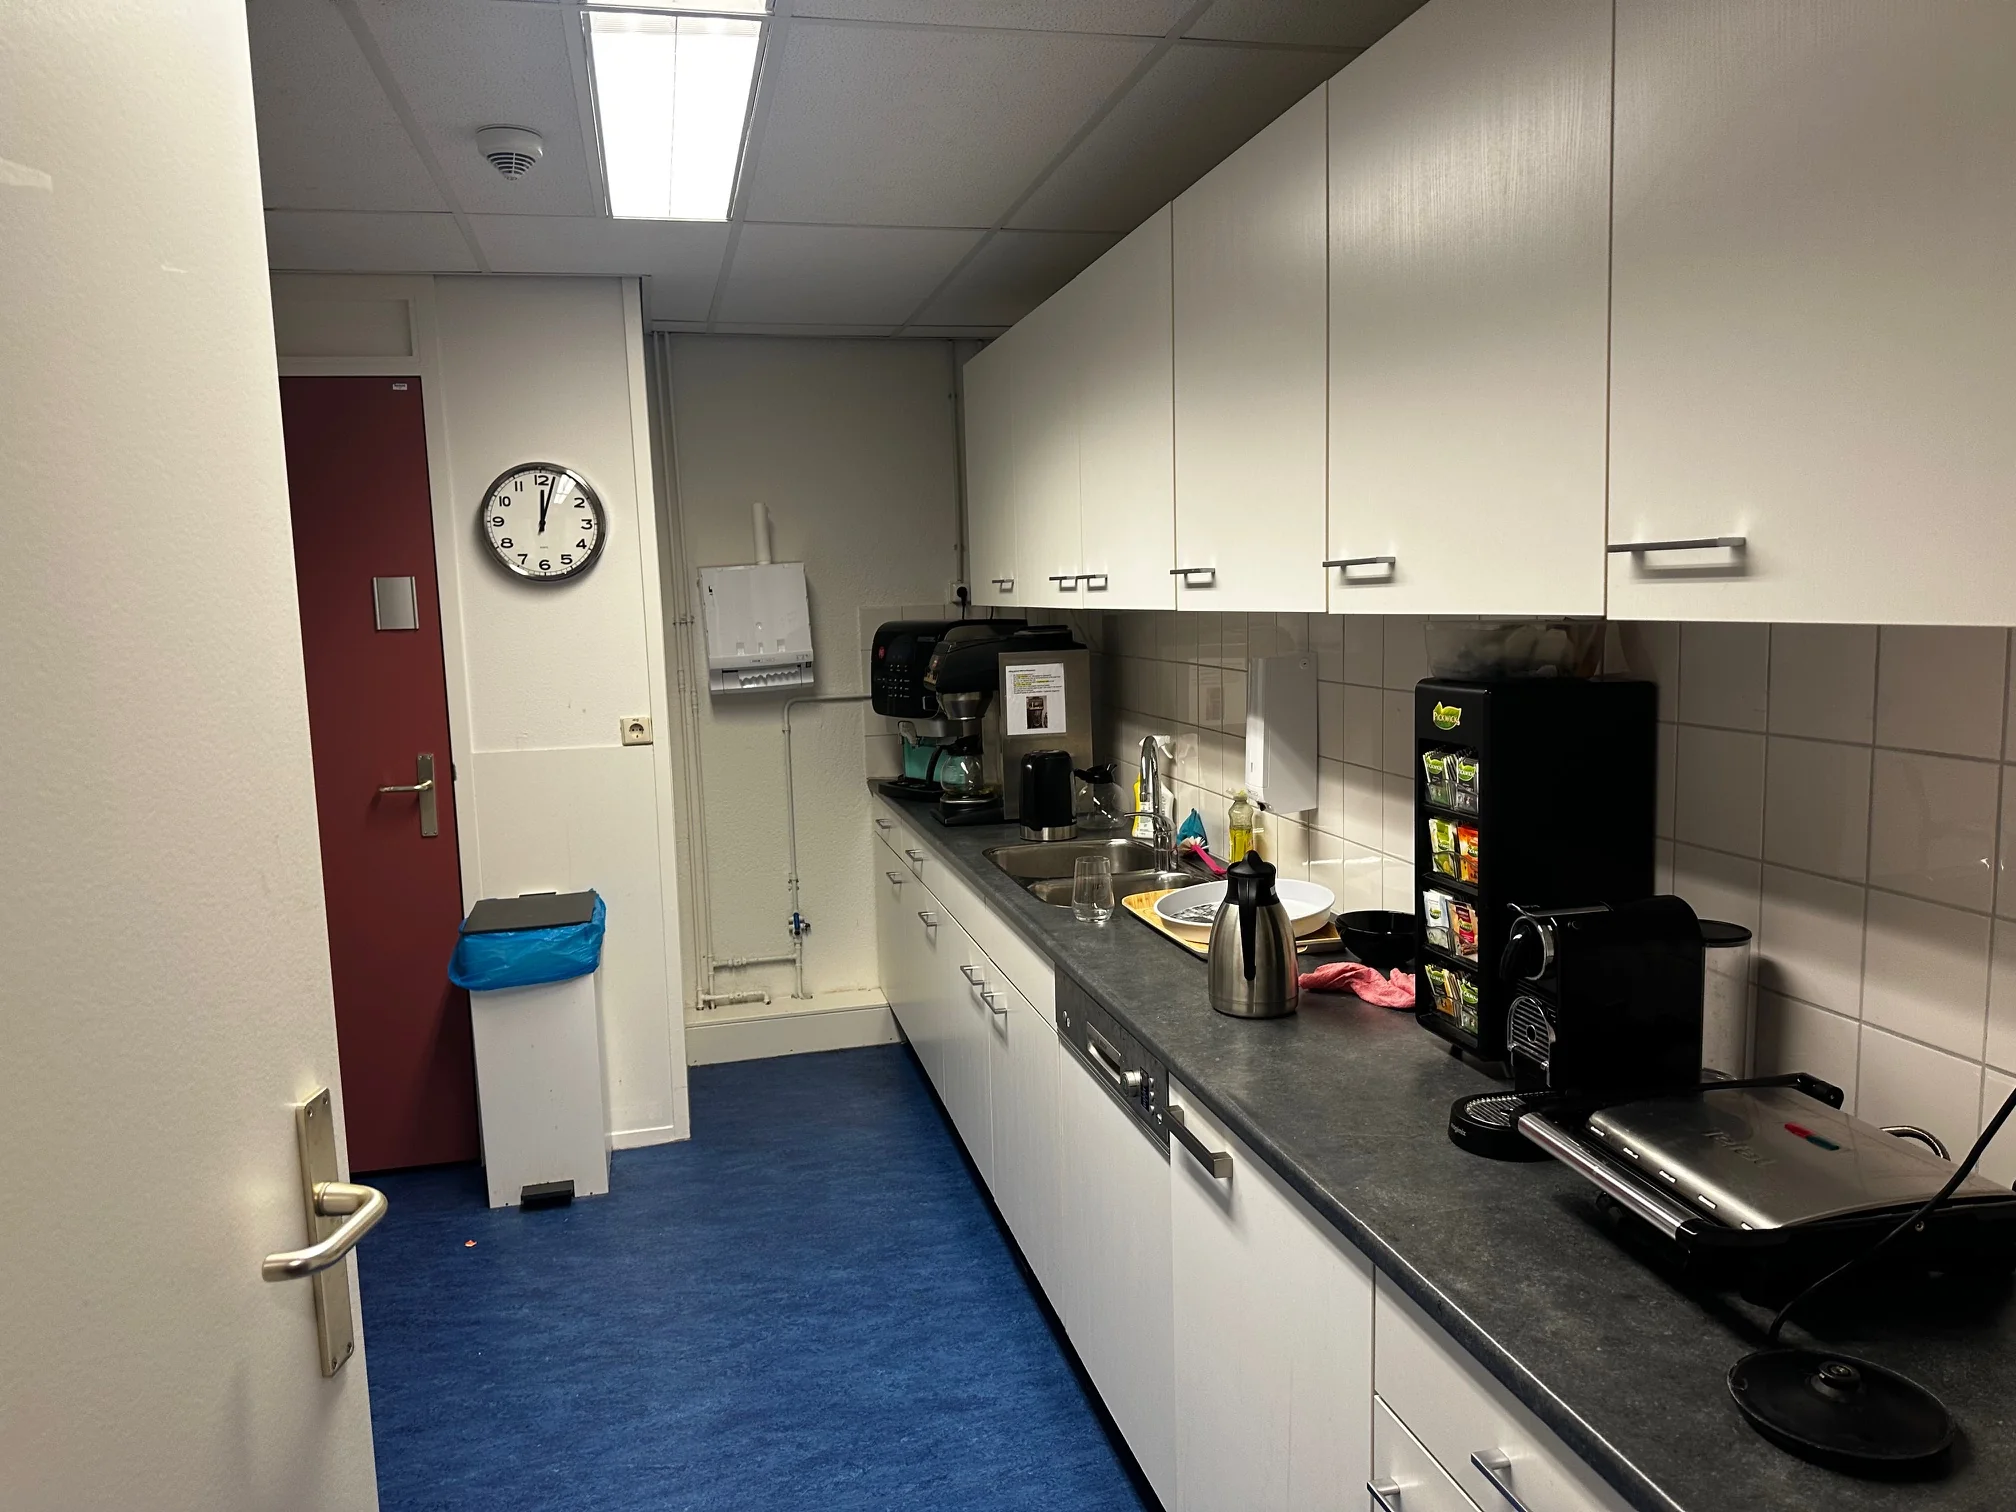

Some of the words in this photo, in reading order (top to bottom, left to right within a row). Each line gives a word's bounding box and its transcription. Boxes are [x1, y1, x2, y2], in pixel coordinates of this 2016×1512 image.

[534, 474, 549, 486] 12
[514, 480, 523, 492] 11
[499, 496, 511, 507] 10
[573, 497, 585, 508] 2
[492, 516, 505, 527] 9
[580, 518, 593, 530] 3
[500, 537, 514, 549] 8
[575, 538, 587, 549] 4
[517, 553, 528, 565] 7
[538, 559, 551, 570] 6
[560, 554, 573, 565] 5
